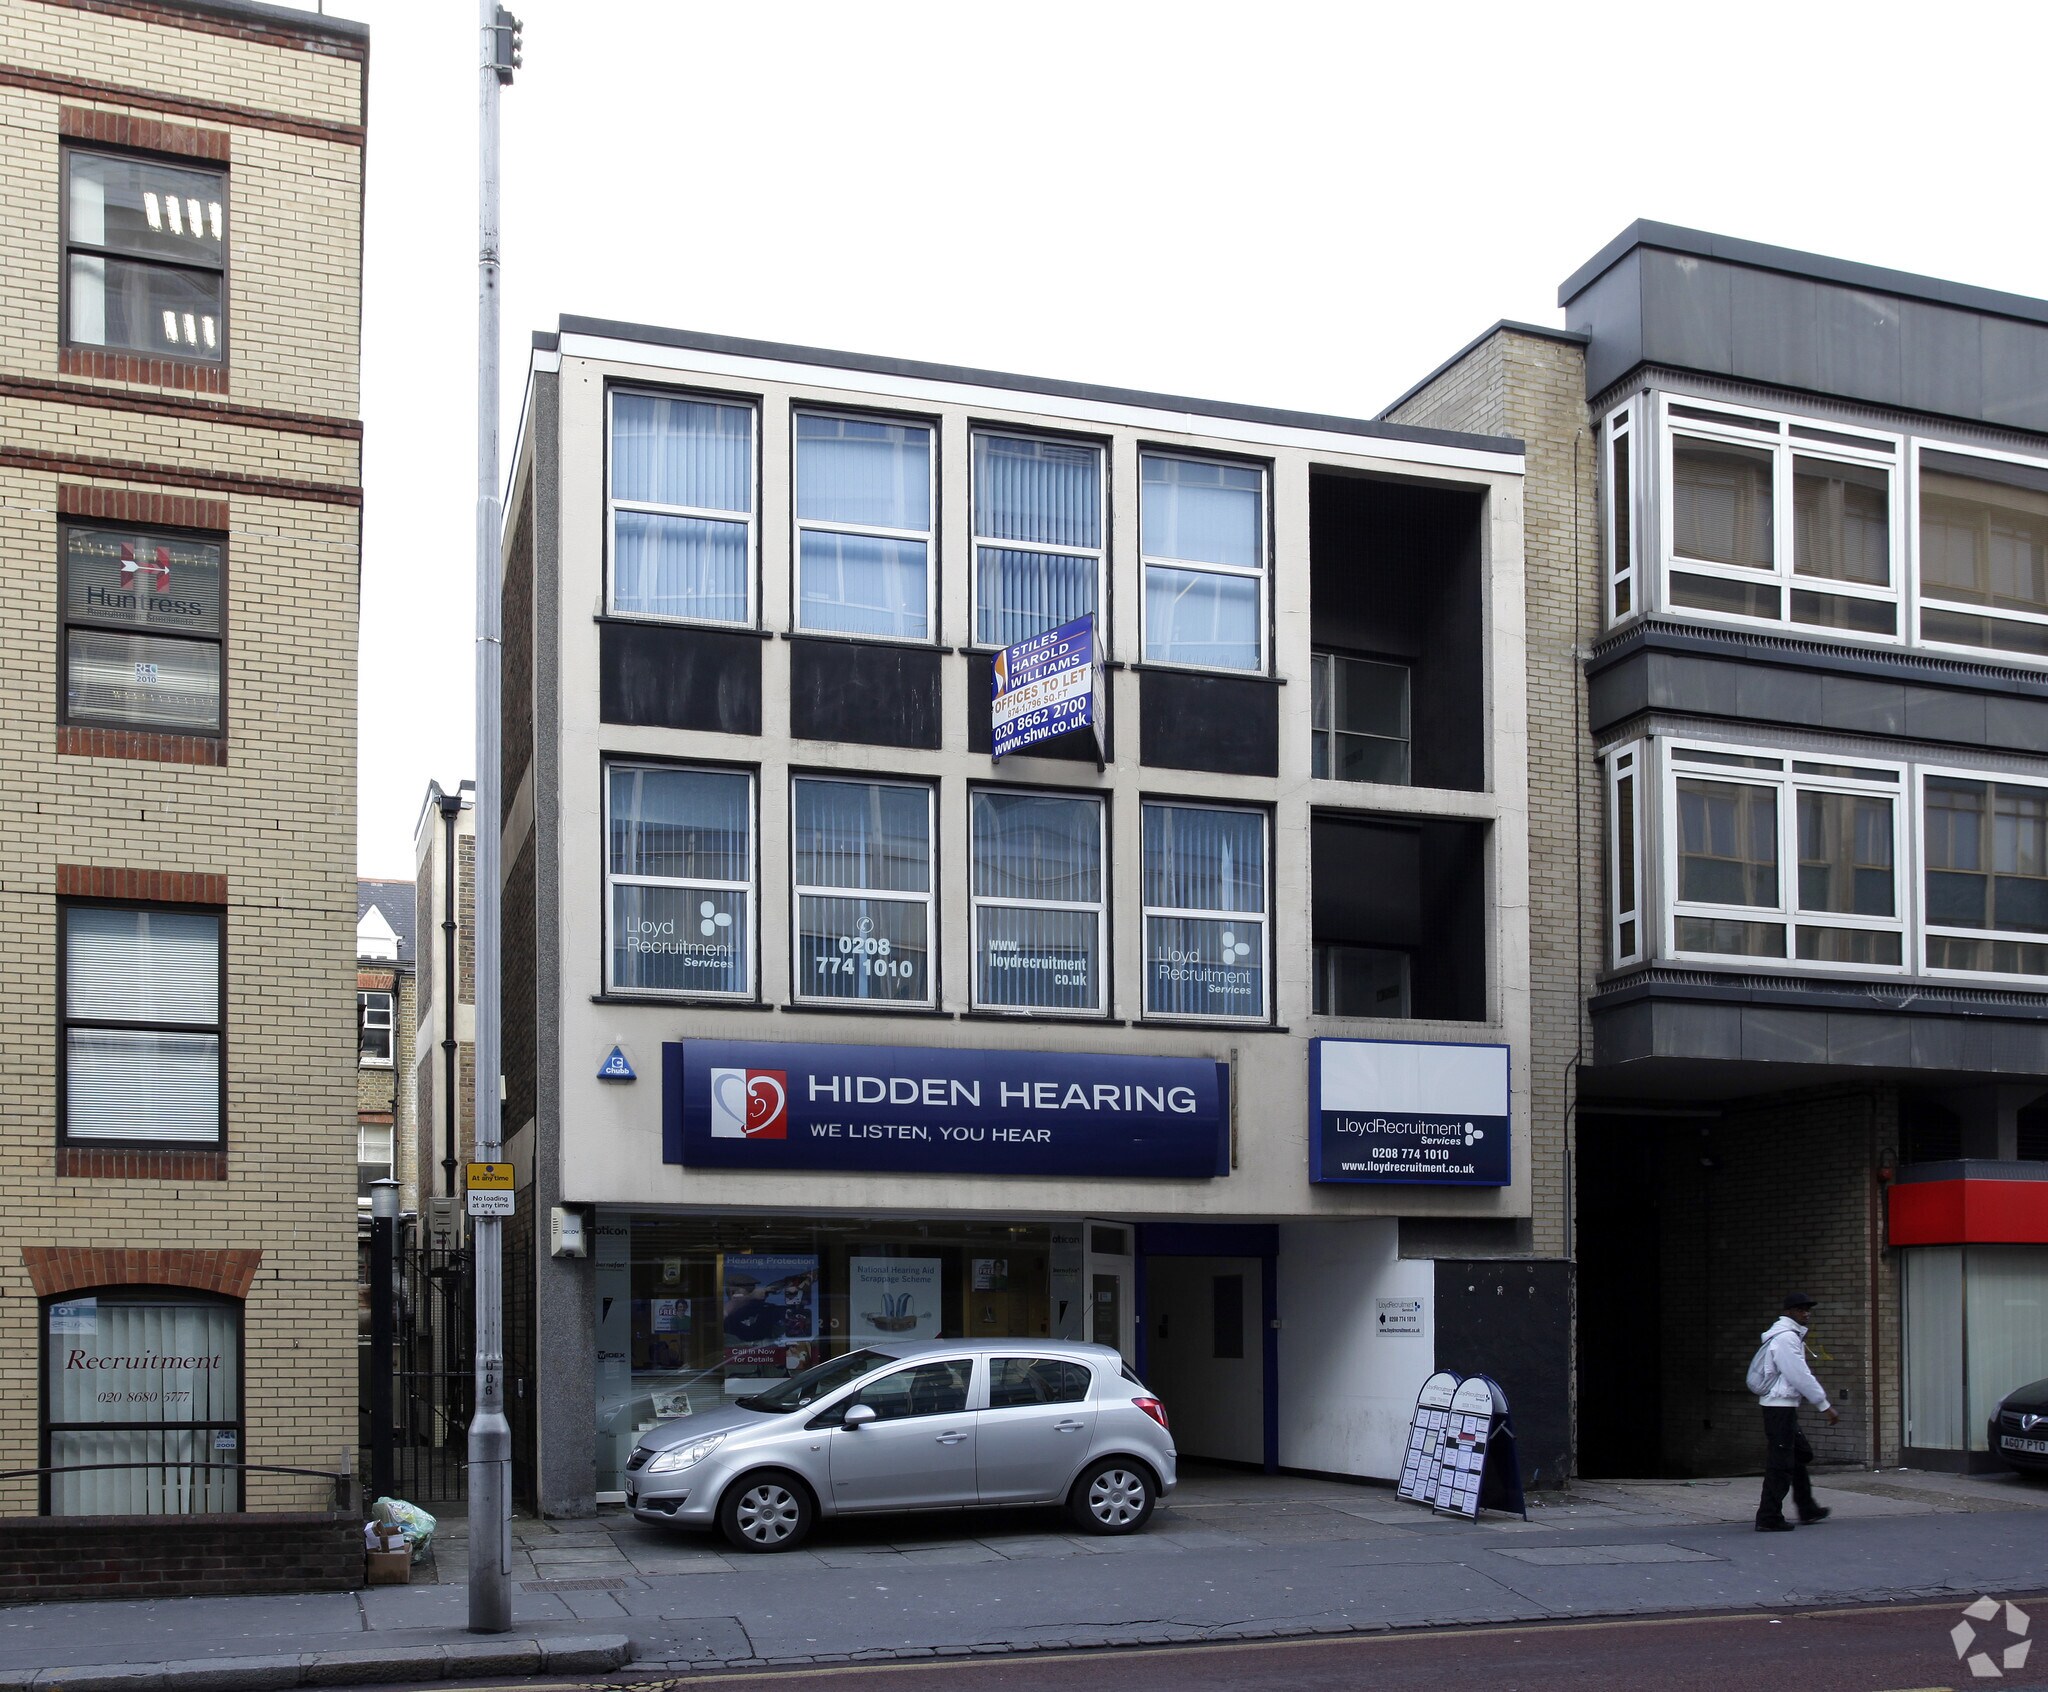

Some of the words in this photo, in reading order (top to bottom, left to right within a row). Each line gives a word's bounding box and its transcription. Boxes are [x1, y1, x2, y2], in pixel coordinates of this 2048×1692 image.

[87, 586, 202, 616] Huntress
[1012, 631, 1058, 659] STILES
[1011, 643, 1069, 674] HAROLD
[136, 675, 157, 684] 2010
[1010, 654, 1080, 689] WILLIAMS
[995, 685, 1038, 714] OFFICES
[1042, 678, 1059, 693] TO
[1063, 668, 1087, 687] LET
[995, 722, 1014, 740] 020
[1017, 709, 1049, 731] 8662
[1053, 697, 1087, 719] 2700
[994, 712, 1087, 756] www.shw.co.uk
[627, 916, 674, 938] Lloyd
[627, 937, 733, 957] Recruitment
[839, 936, 891, 955] 0208
[989, 940, 1020, 951] www.
[684, 957, 734, 968] Services
[989, 953, 1087, 971] lloydrecruitment
[1159, 946, 1200, 965] Lloyd
[816, 957, 855, 975] 774
[863, 959, 913, 978] 1010
[1159, 965, 1251, 984] Recruitment
[1055, 972, 1087, 986] co.uk
[1208, 984, 1252, 995] Services
[808, 1074, 980, 1107] HIDDEN
[1000, 1081, 1197, 1114] HEARING
[810, 1123, 842, 1138] WE
[848, 1124, 932, 1142] LISTEN,
[939, 1126, 986, 1142] YOU
[992, 1128, 1052, 1143] HEAR
[1336, 1117, 1461, 1137] LloydRecruitment
[1421, 1136, 1461, 1145] Services
[1372, 1147, 1398, 1159] 0208
[1401, 1148, 1420, 1159] 774
[1424, 1149, 1449, 1160] 1010
[1341, 1161, 1475, 1174] www.lloydrecruitment.co.uk
[595, 1226, 628, 1236] oticon
[727, 1257, 763, 1265] Hearing
[766, 1257, 815, 1265] Protection
[857, 1266, 889, 1274] National
[892, 1266, 920, 1275] Hearing
[860, 1275, 899, 1284] Scrappage
[902, 1275, 932, 1283] Scheme
[65, 1349, 222, 1370] Recruitment
[97, 1392, 122, 1403] 020
[126, 1392, 158, 1403] 8680
[163, 1391, 190, 1403] 5777
